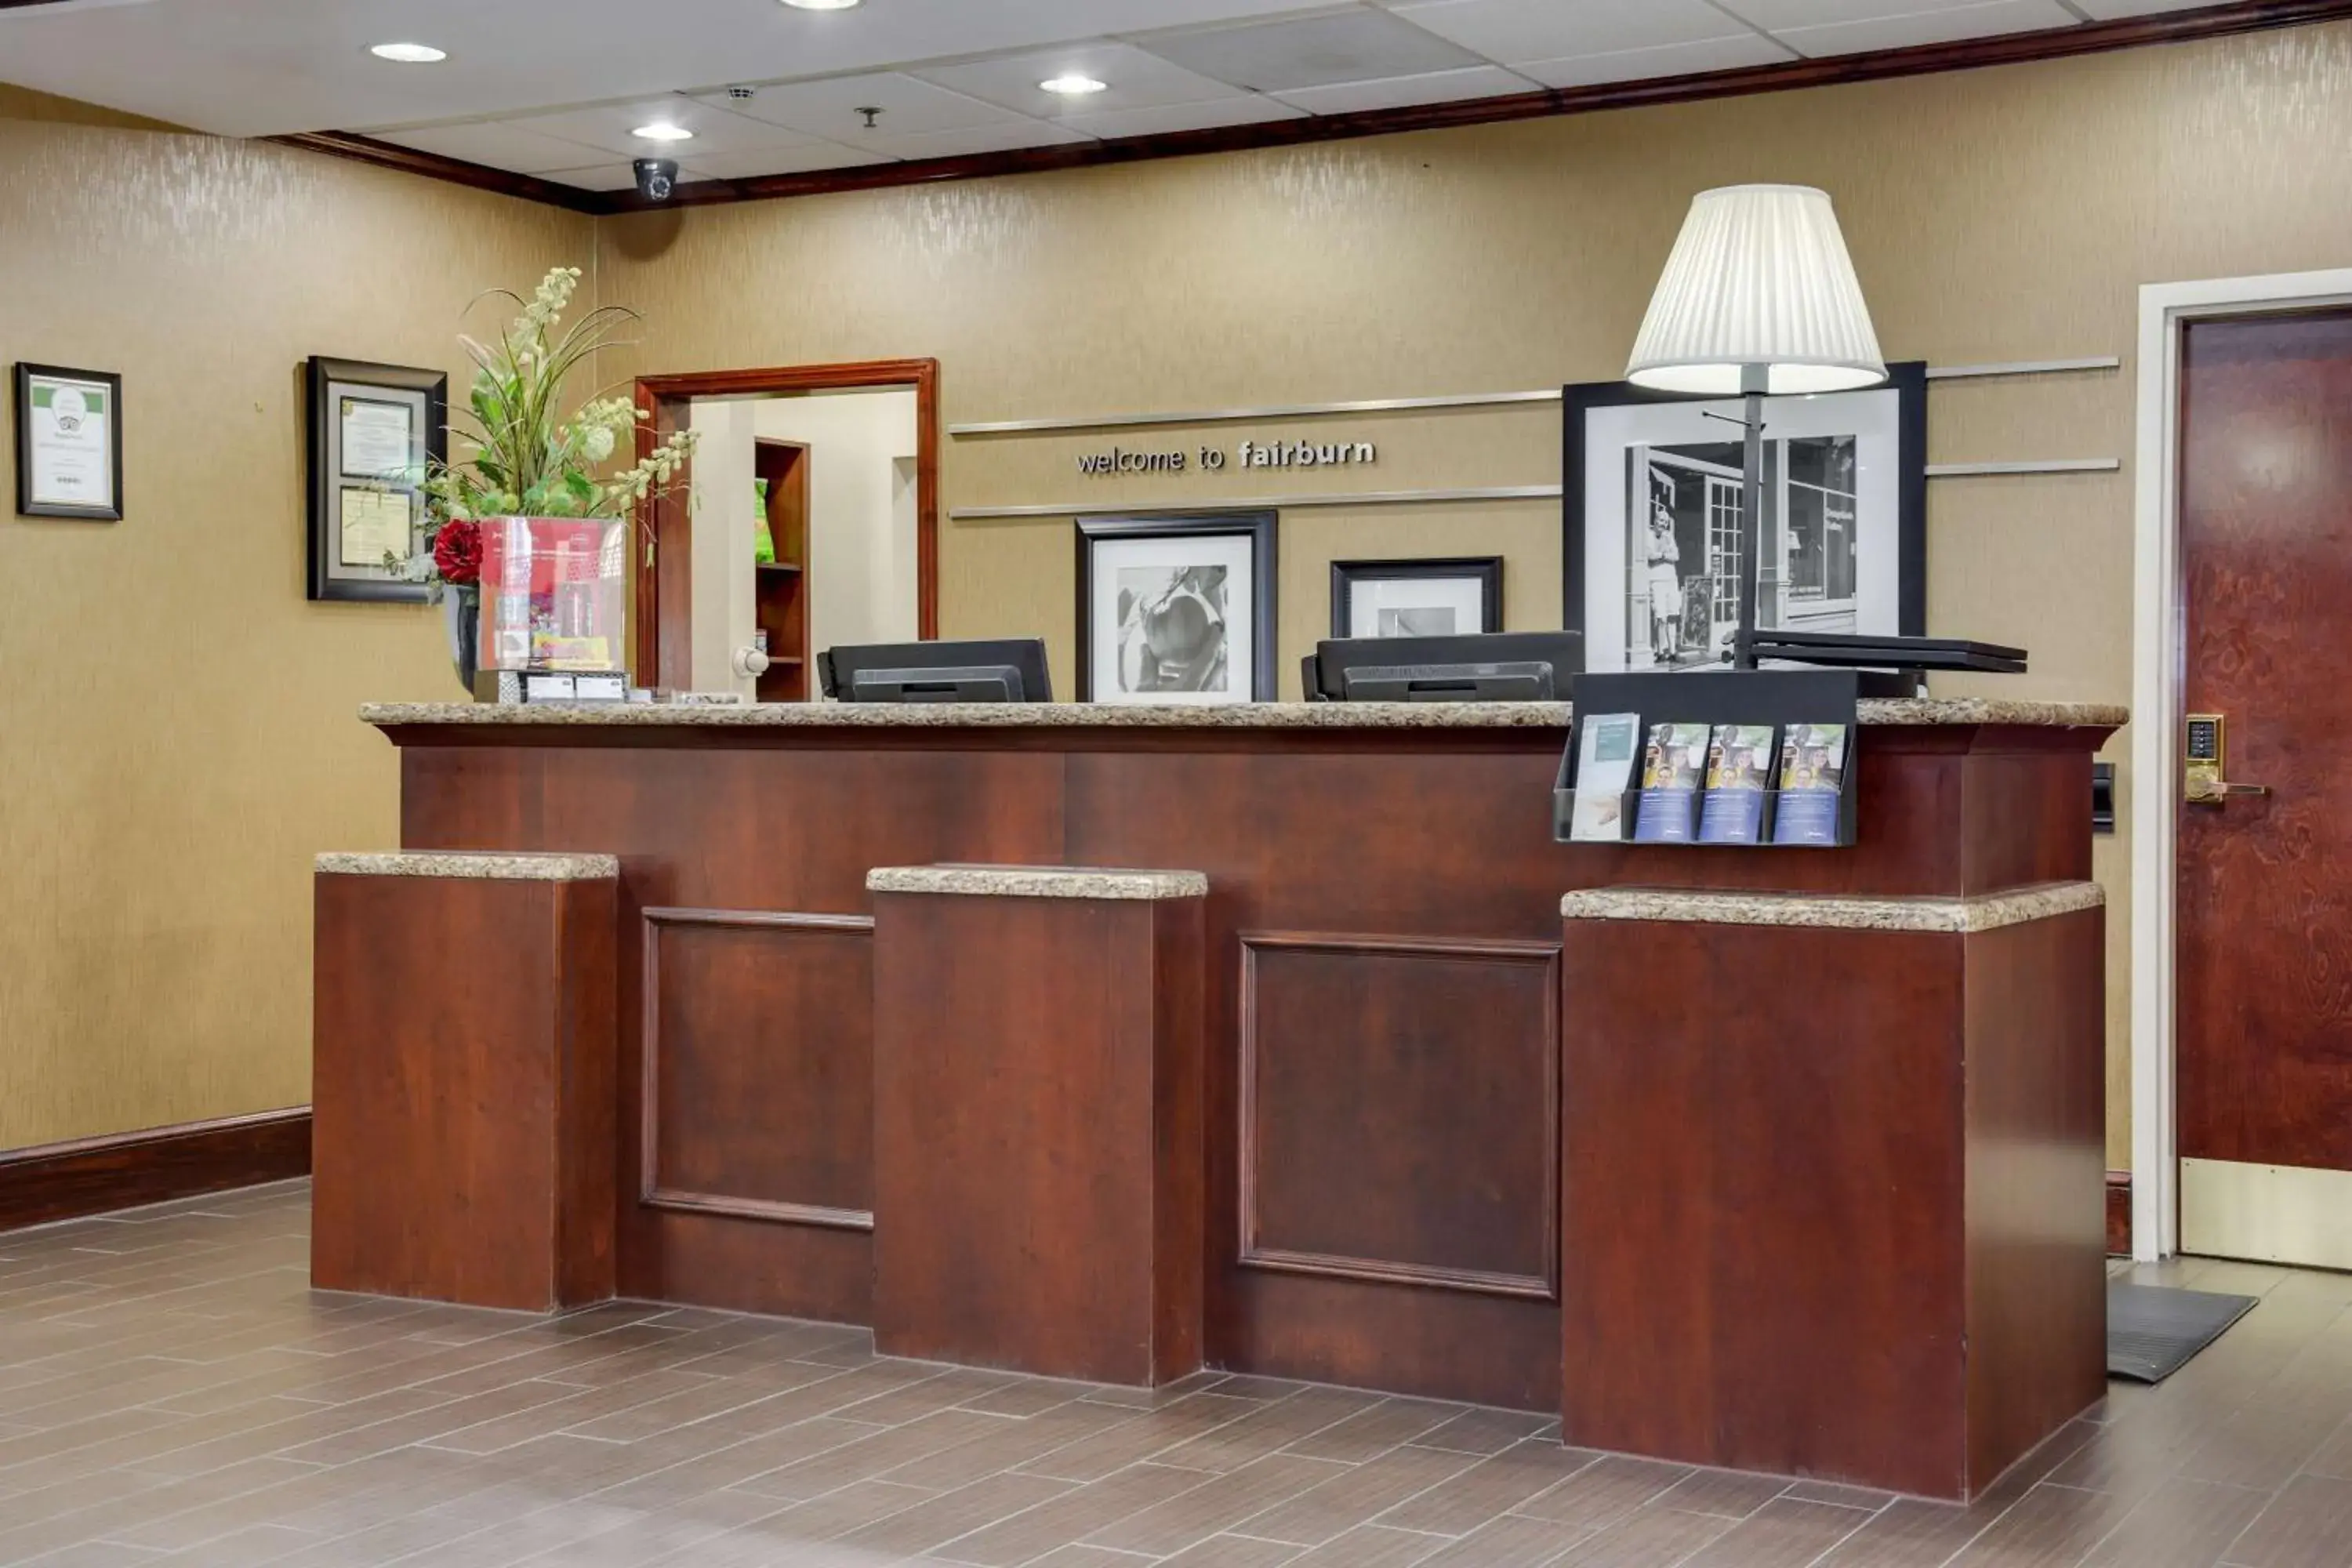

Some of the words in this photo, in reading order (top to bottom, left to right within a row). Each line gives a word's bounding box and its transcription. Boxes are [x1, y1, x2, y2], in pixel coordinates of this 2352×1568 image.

[1077, 446, 1185, 474] welcome
[1199, 446, 1225, 469] to
[1238, 440, 1376, 468] fairburn
